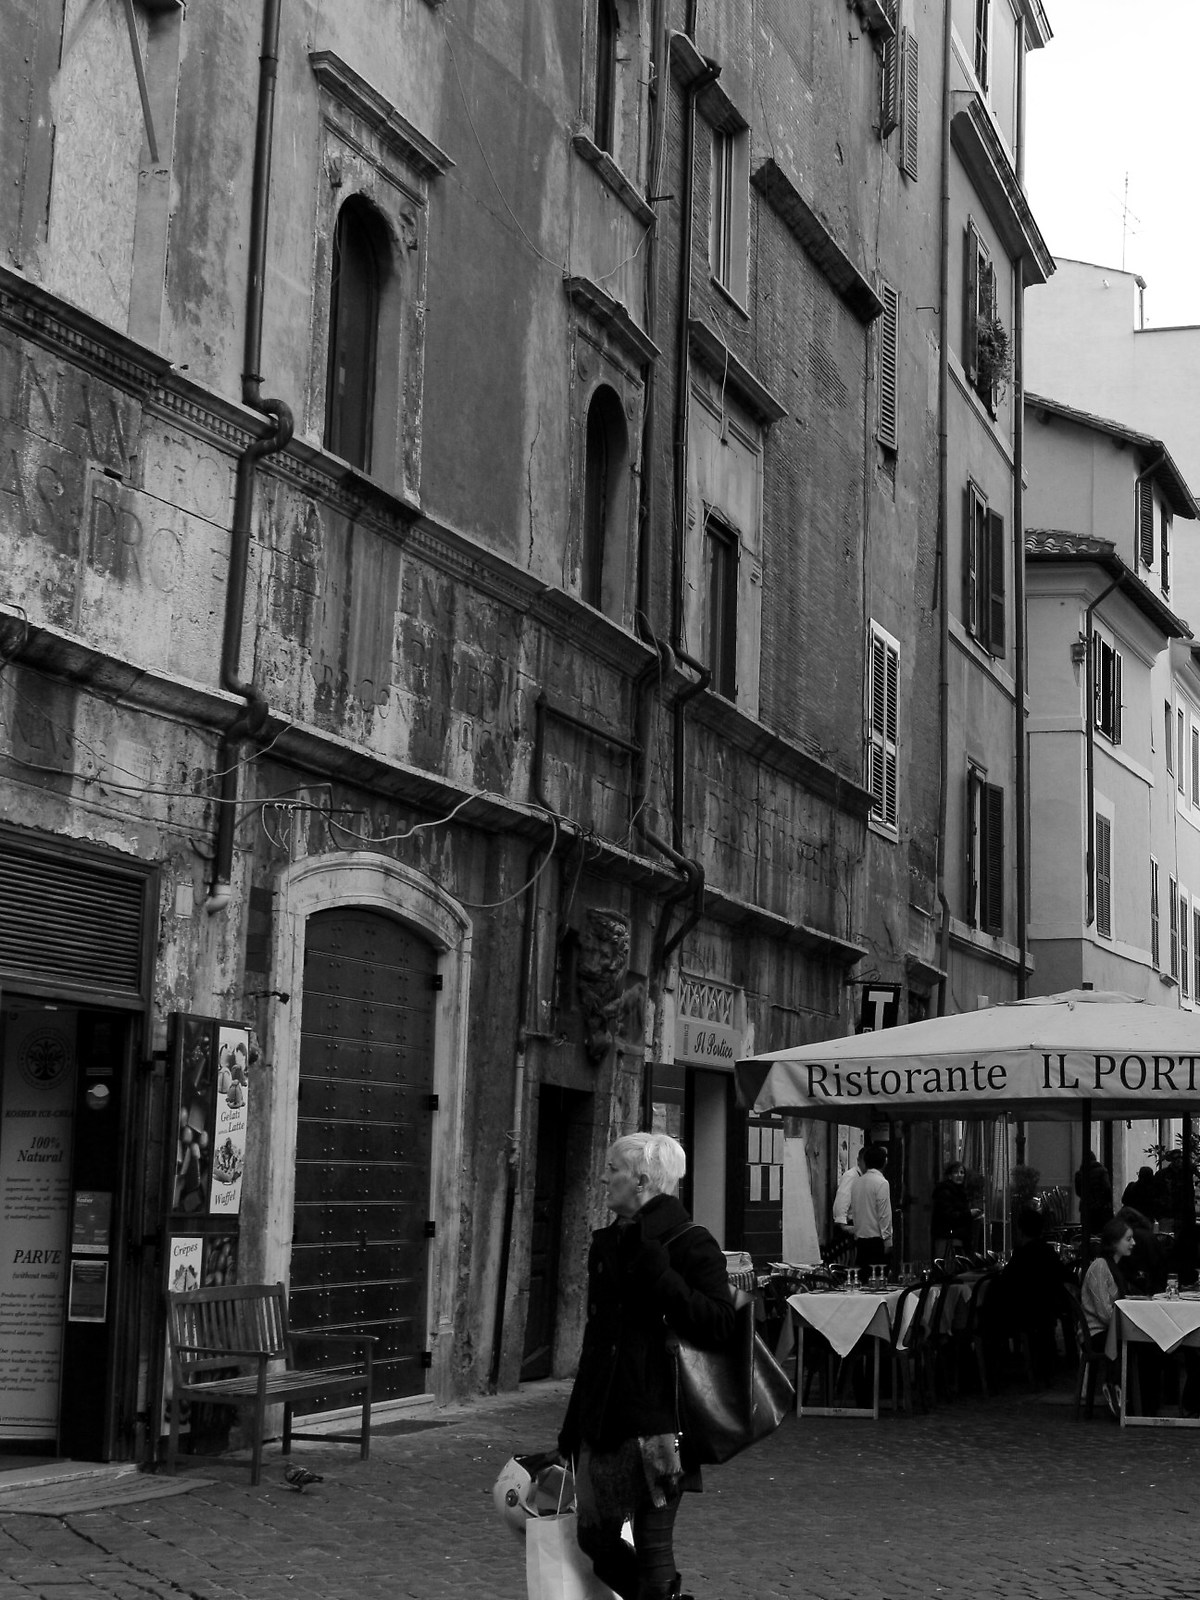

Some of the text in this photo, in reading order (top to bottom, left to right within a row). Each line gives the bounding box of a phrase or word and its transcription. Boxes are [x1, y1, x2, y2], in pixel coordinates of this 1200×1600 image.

[706, 1033, 733, 1058] Portico
[805, 1058, 1009, 1098] Ristorante
[1041, 1053, 1080, 1090] IL
[5, 1110, 37, 1118] KOSHER
[220, 1109, 241, 1122] Gelati
[228, 1122, 245, 1133] Latte
[30, 1136, 61, 1149] 100%
[17, 1150, 63, 1162] Natural
[214, 1190, 237, 1207] Waffel
[13, 1249, 62, 1264] PARVE
